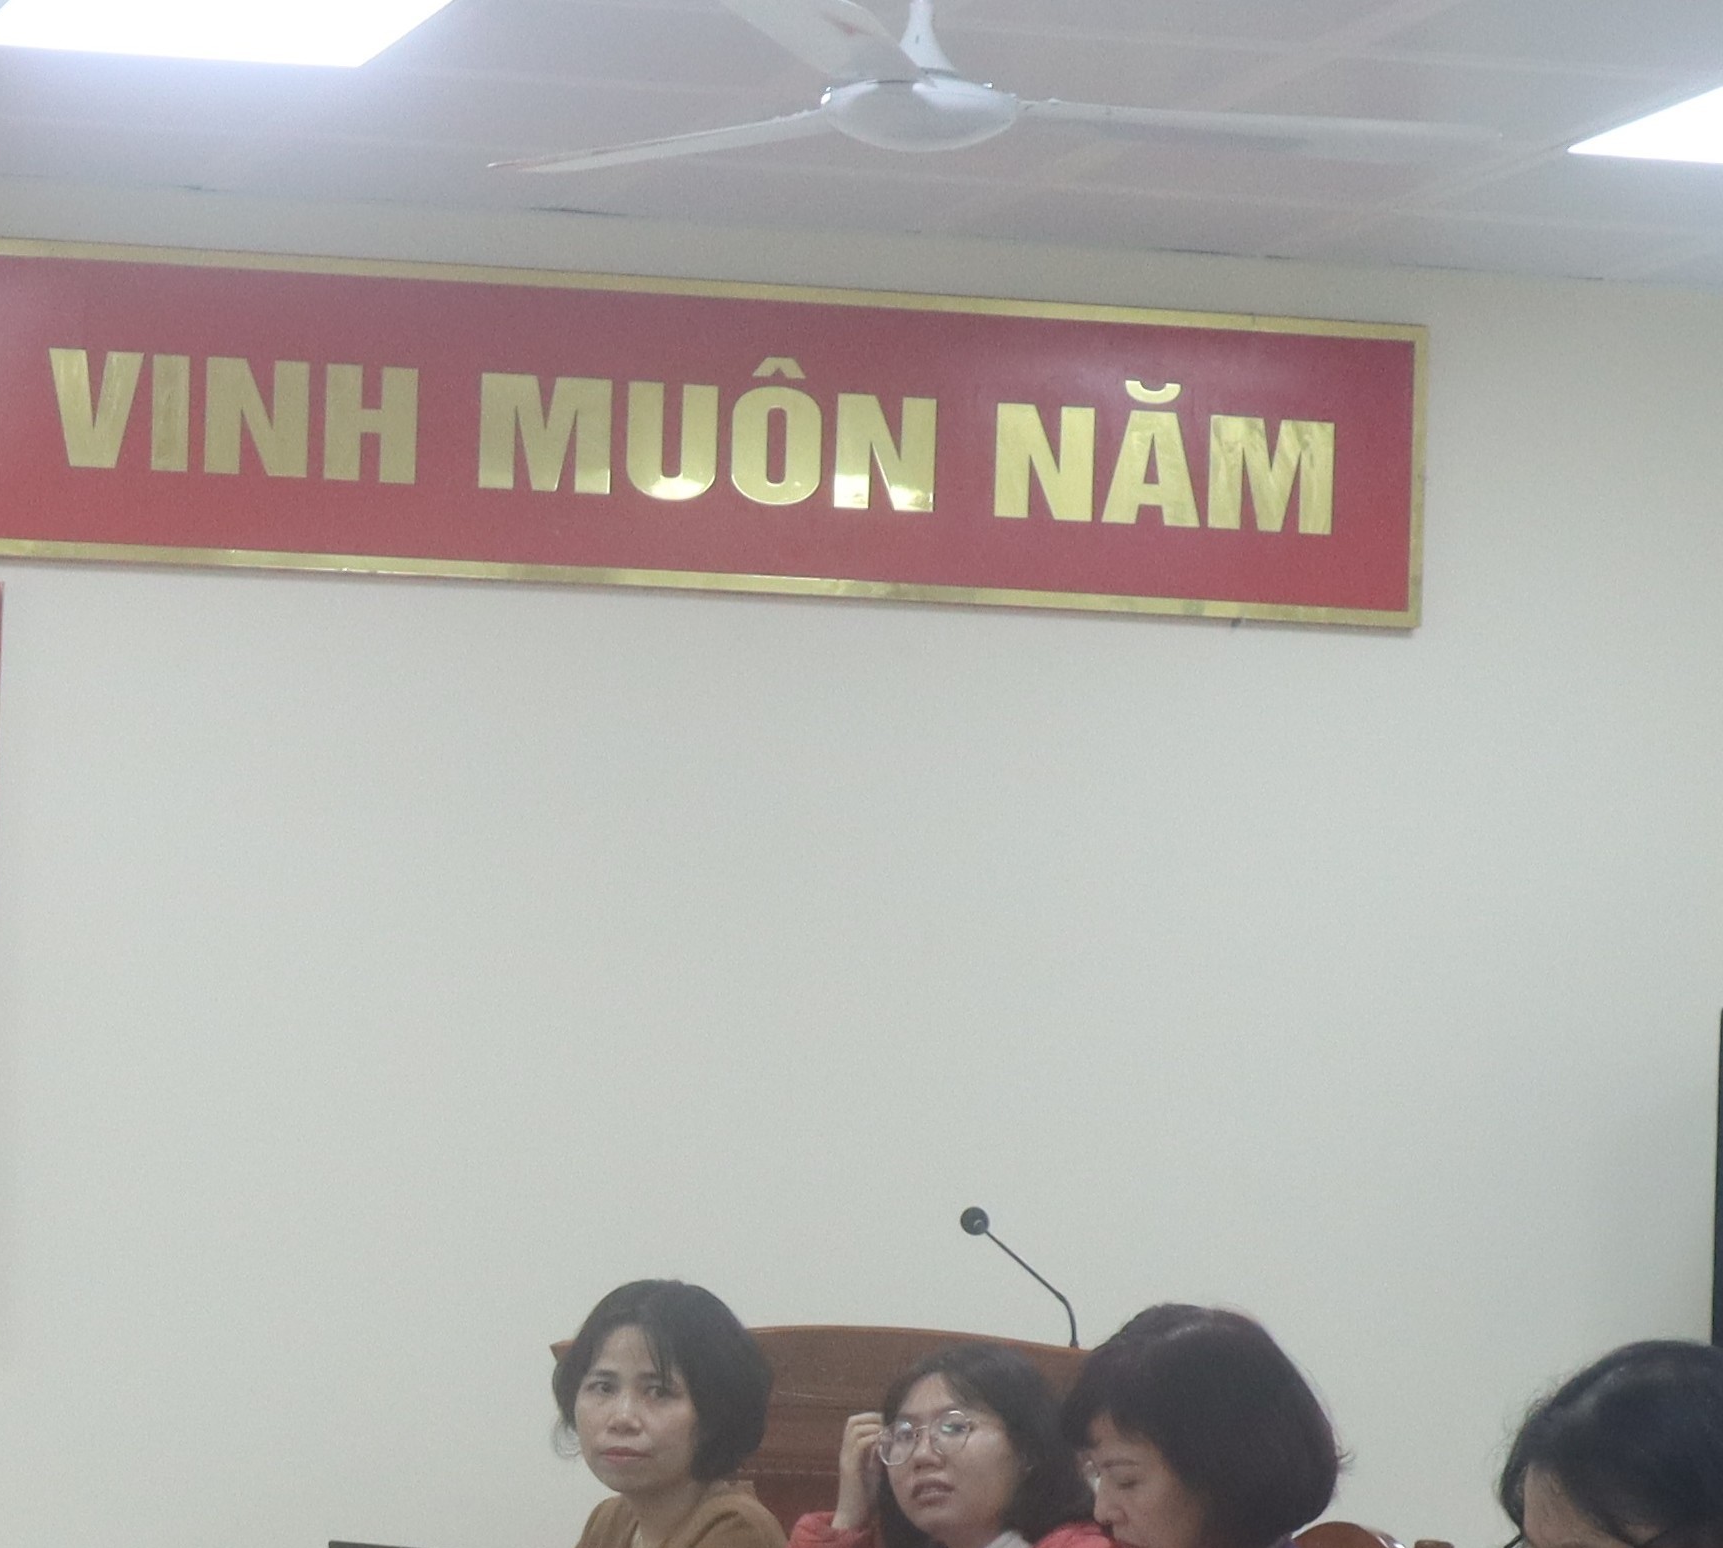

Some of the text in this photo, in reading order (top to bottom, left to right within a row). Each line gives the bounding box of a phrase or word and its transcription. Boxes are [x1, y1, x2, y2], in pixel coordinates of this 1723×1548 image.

[48, 344, 420, 486] VINH
[475, 355, 939, 517] MUÔN
[994, 377, 1336, 537] NĂM
